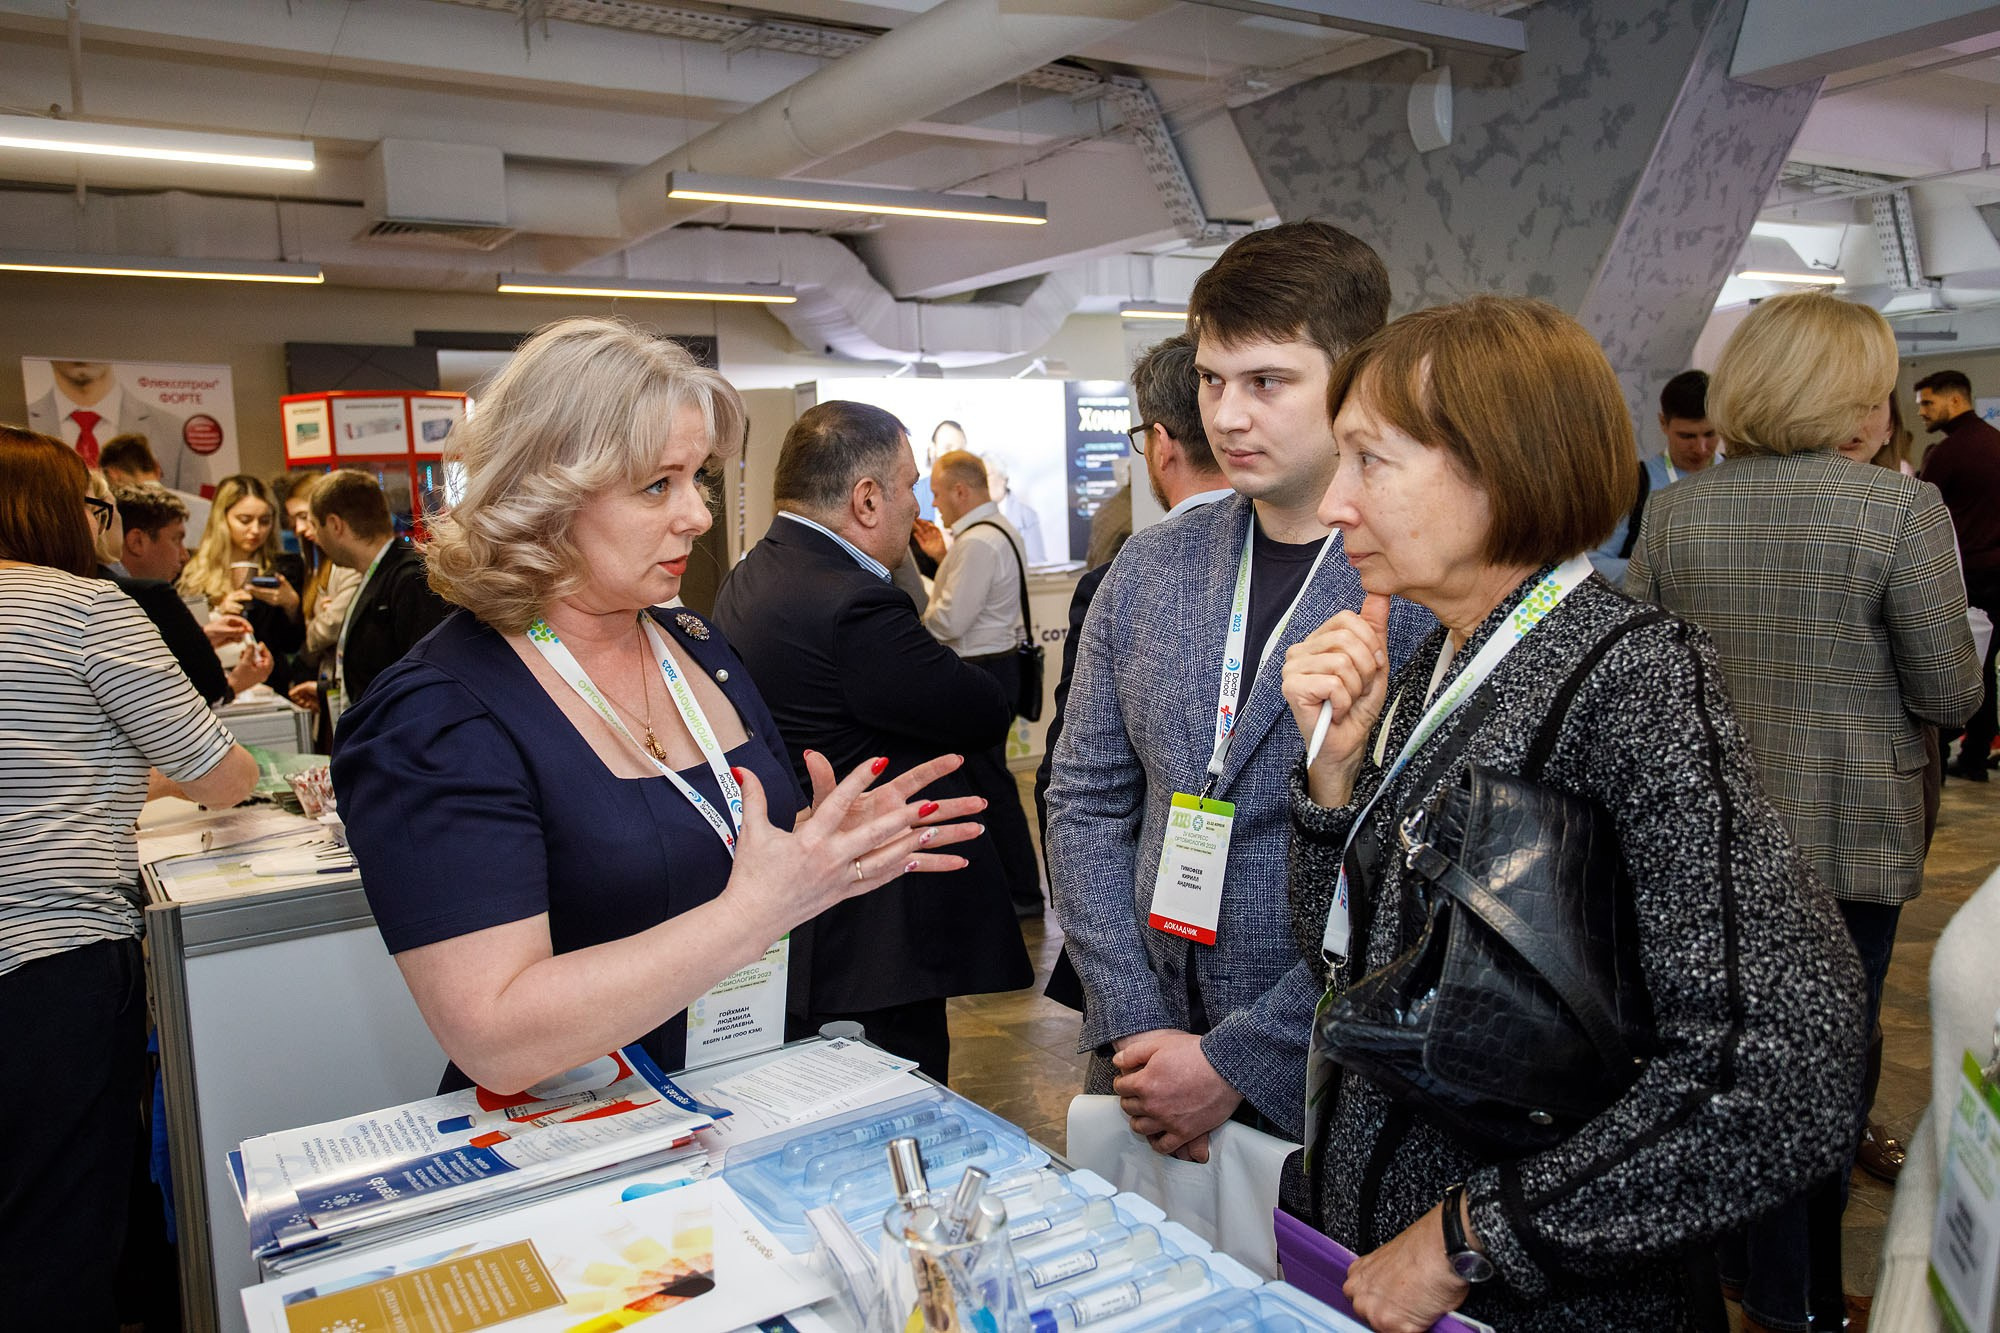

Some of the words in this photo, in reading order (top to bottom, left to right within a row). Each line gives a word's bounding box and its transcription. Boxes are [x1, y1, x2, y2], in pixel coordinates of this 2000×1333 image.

[160, 393, 202, 405] ФОРТЕ
[1232, 614, 1241, 633] 2023
[662, 659, 678, 682] 2023
[1222, 671, 1231, 697] School
[1230, 672, 1239, 698] Doctor
[673, 681, 714, 751] ОРТОБИОЛОГИЯ
[719, 773, 733, 799] Doctor
[724, 772, 740, 798] School
[700, 803, 722, 829] School
[703, 799, 723, 824] Doctor
[1180, 865, 1203, 875] ТИМОФЕЕВ
[1182, 873, 1200, 882] КИРИЛЛ
[1177, 880, 1202, 891] АНДРЕЕВИЧ
[1163, 921, 1198, 937] ДОКЛАДЧИК
[757, 971, 772, 979] 2023
[717, 1013, 751, 1025] ЛЮДМИЛА
[719, 1006, 750, 1018] ГОЙХМАН
[712, 1019, 754, 1034] НИКОЛАЕВНА
